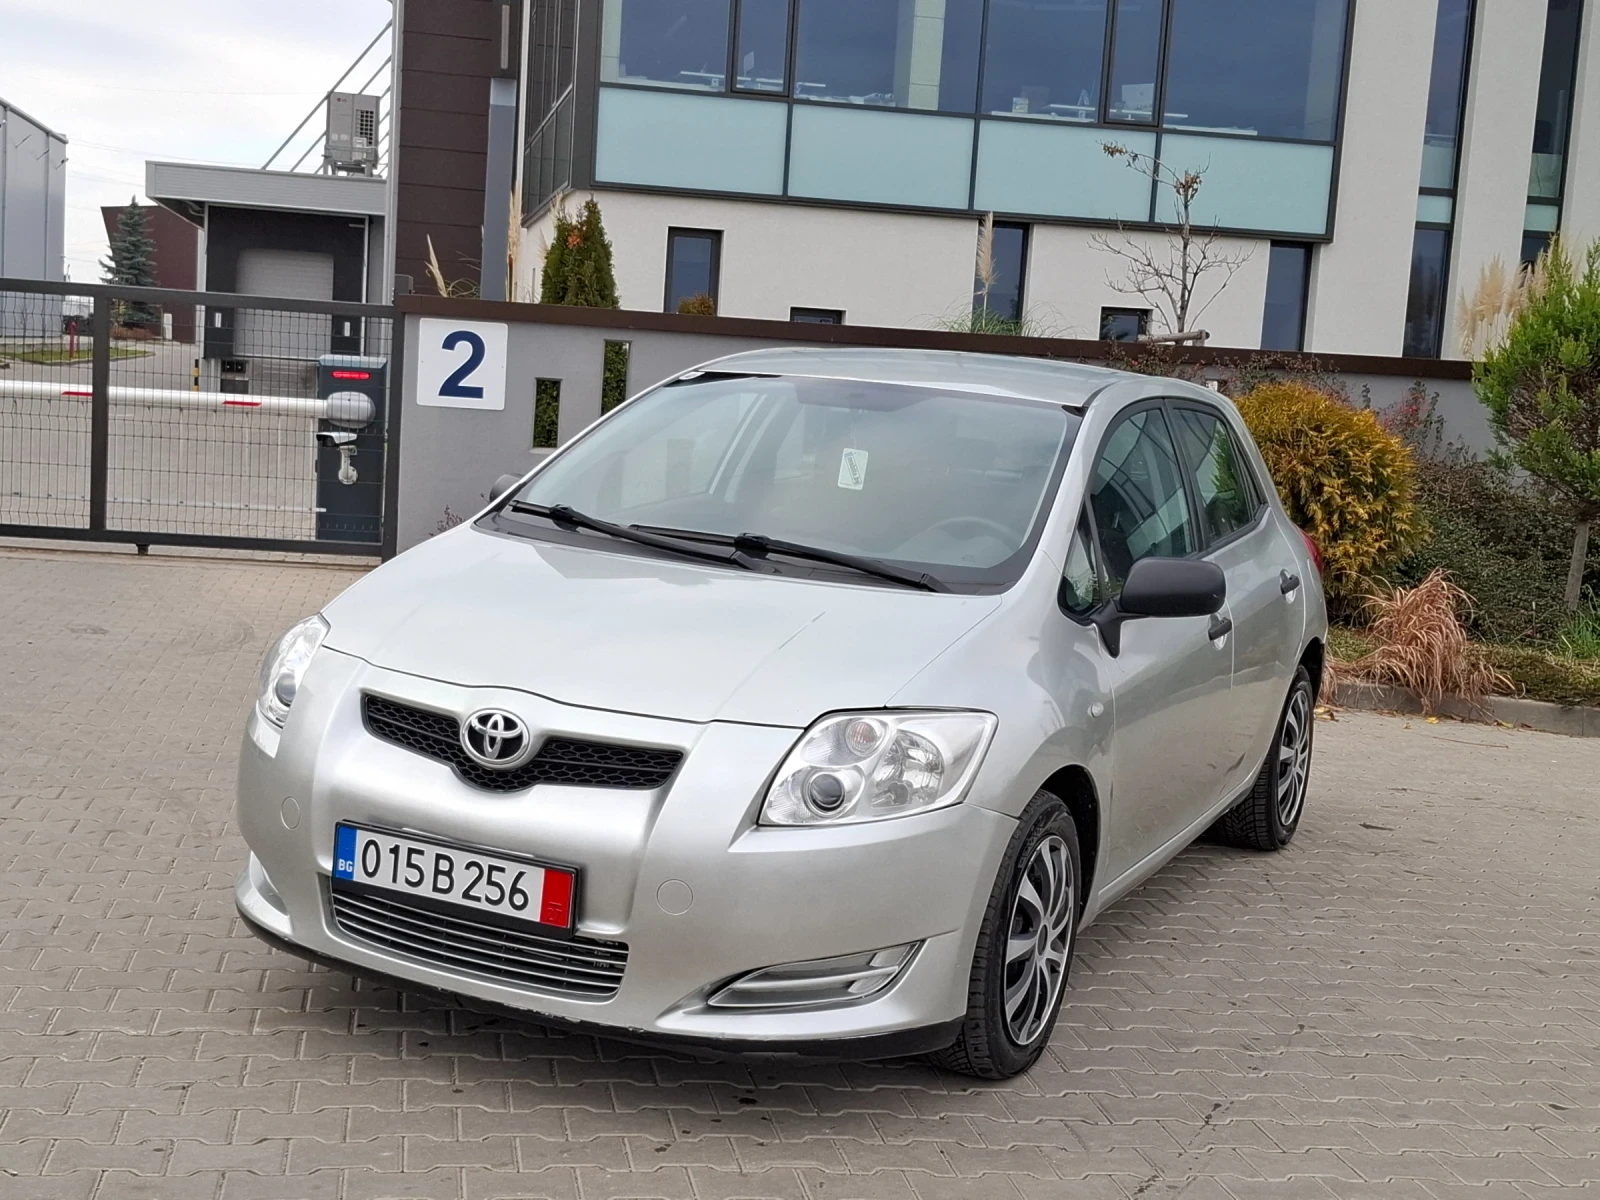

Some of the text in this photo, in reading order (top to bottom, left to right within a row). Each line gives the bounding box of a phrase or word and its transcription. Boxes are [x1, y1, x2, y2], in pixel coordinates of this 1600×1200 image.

[438, 330, 486, 399] 2
[338, 858, 353, 873] BG
[361, 839, 530, 912] 015B256
